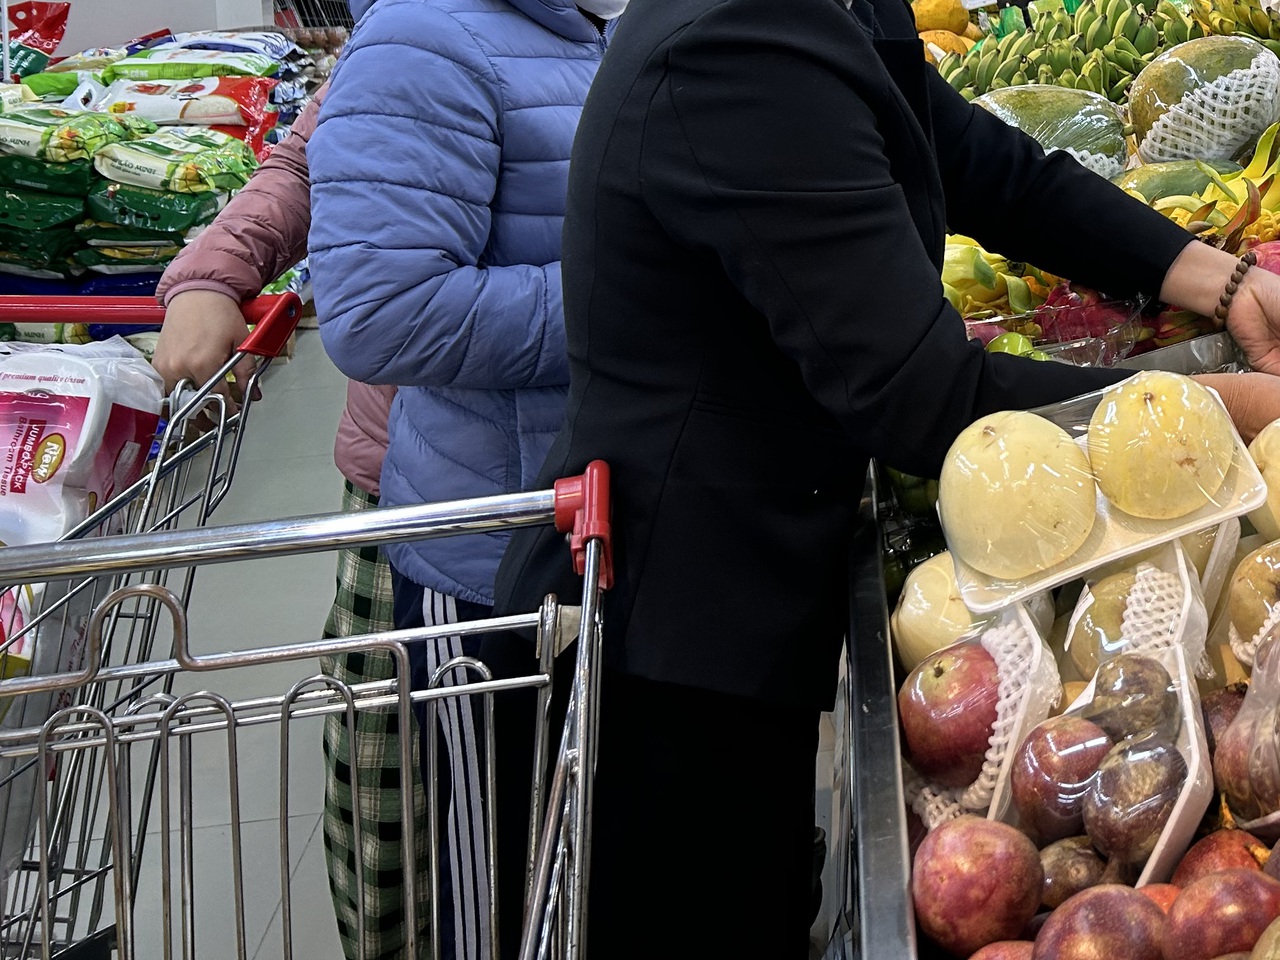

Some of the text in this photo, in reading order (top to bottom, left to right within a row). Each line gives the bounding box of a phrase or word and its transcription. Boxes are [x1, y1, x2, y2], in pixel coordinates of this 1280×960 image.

[2, 373, 36, 381] premium
[37, 374, 63, 384] quality
[64, 375, 86, 384] tissue
[6, 416, 27, 463] Bathroom
[37, 441, 61, 478] New
